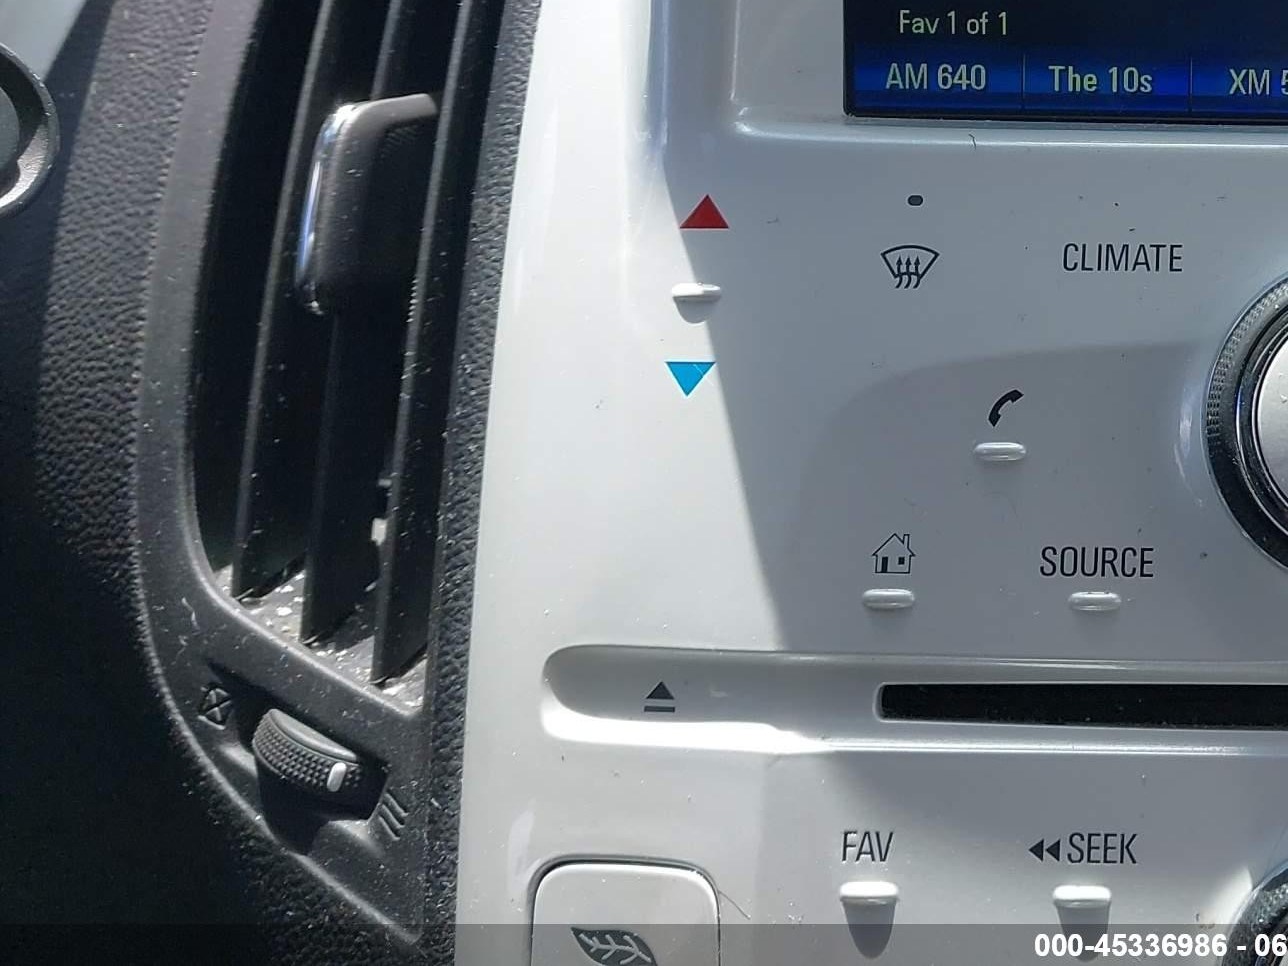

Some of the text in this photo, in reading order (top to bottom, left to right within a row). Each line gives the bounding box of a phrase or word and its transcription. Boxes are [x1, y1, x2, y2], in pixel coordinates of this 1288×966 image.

[899, 11, 1008, 35] Fav 1 of 1
[886, 64, 986, 90] AM 640
[1049, 66, 1152, 93] The 10s
[1229, 69, 1270, 95] XM
[1063, 243, 1183, 272] CLIMATE
[1039, 546, 1154, 577] SOURCE
[842, 831, 893, 861] FAV
[1067, 833, 1137, 864] SEEK
